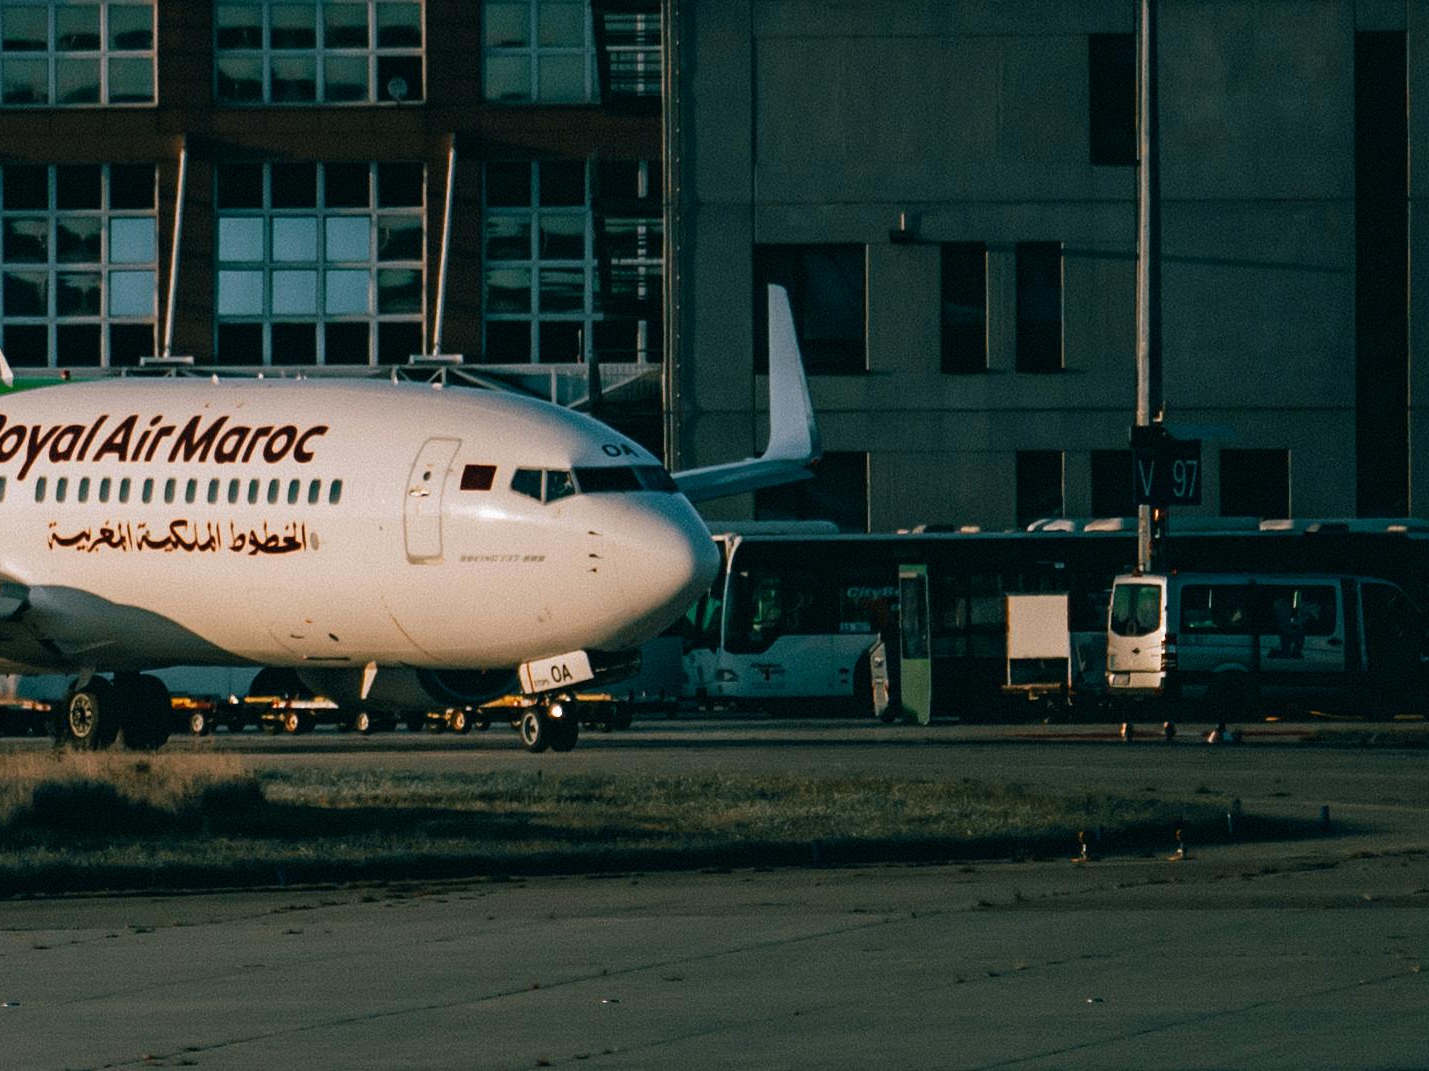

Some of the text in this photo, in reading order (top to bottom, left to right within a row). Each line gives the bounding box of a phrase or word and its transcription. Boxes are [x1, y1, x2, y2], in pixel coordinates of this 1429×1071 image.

[92, 415, 176, 462] Air
[168, 415, 329, 463] Maroc
[602, 443, 639, 458] OA
[1138, 459, 1198, 498] V 97
[47, 519, 306, 555] الخطوط الملكية المغربية
[551, 664, 573, 683] OA
